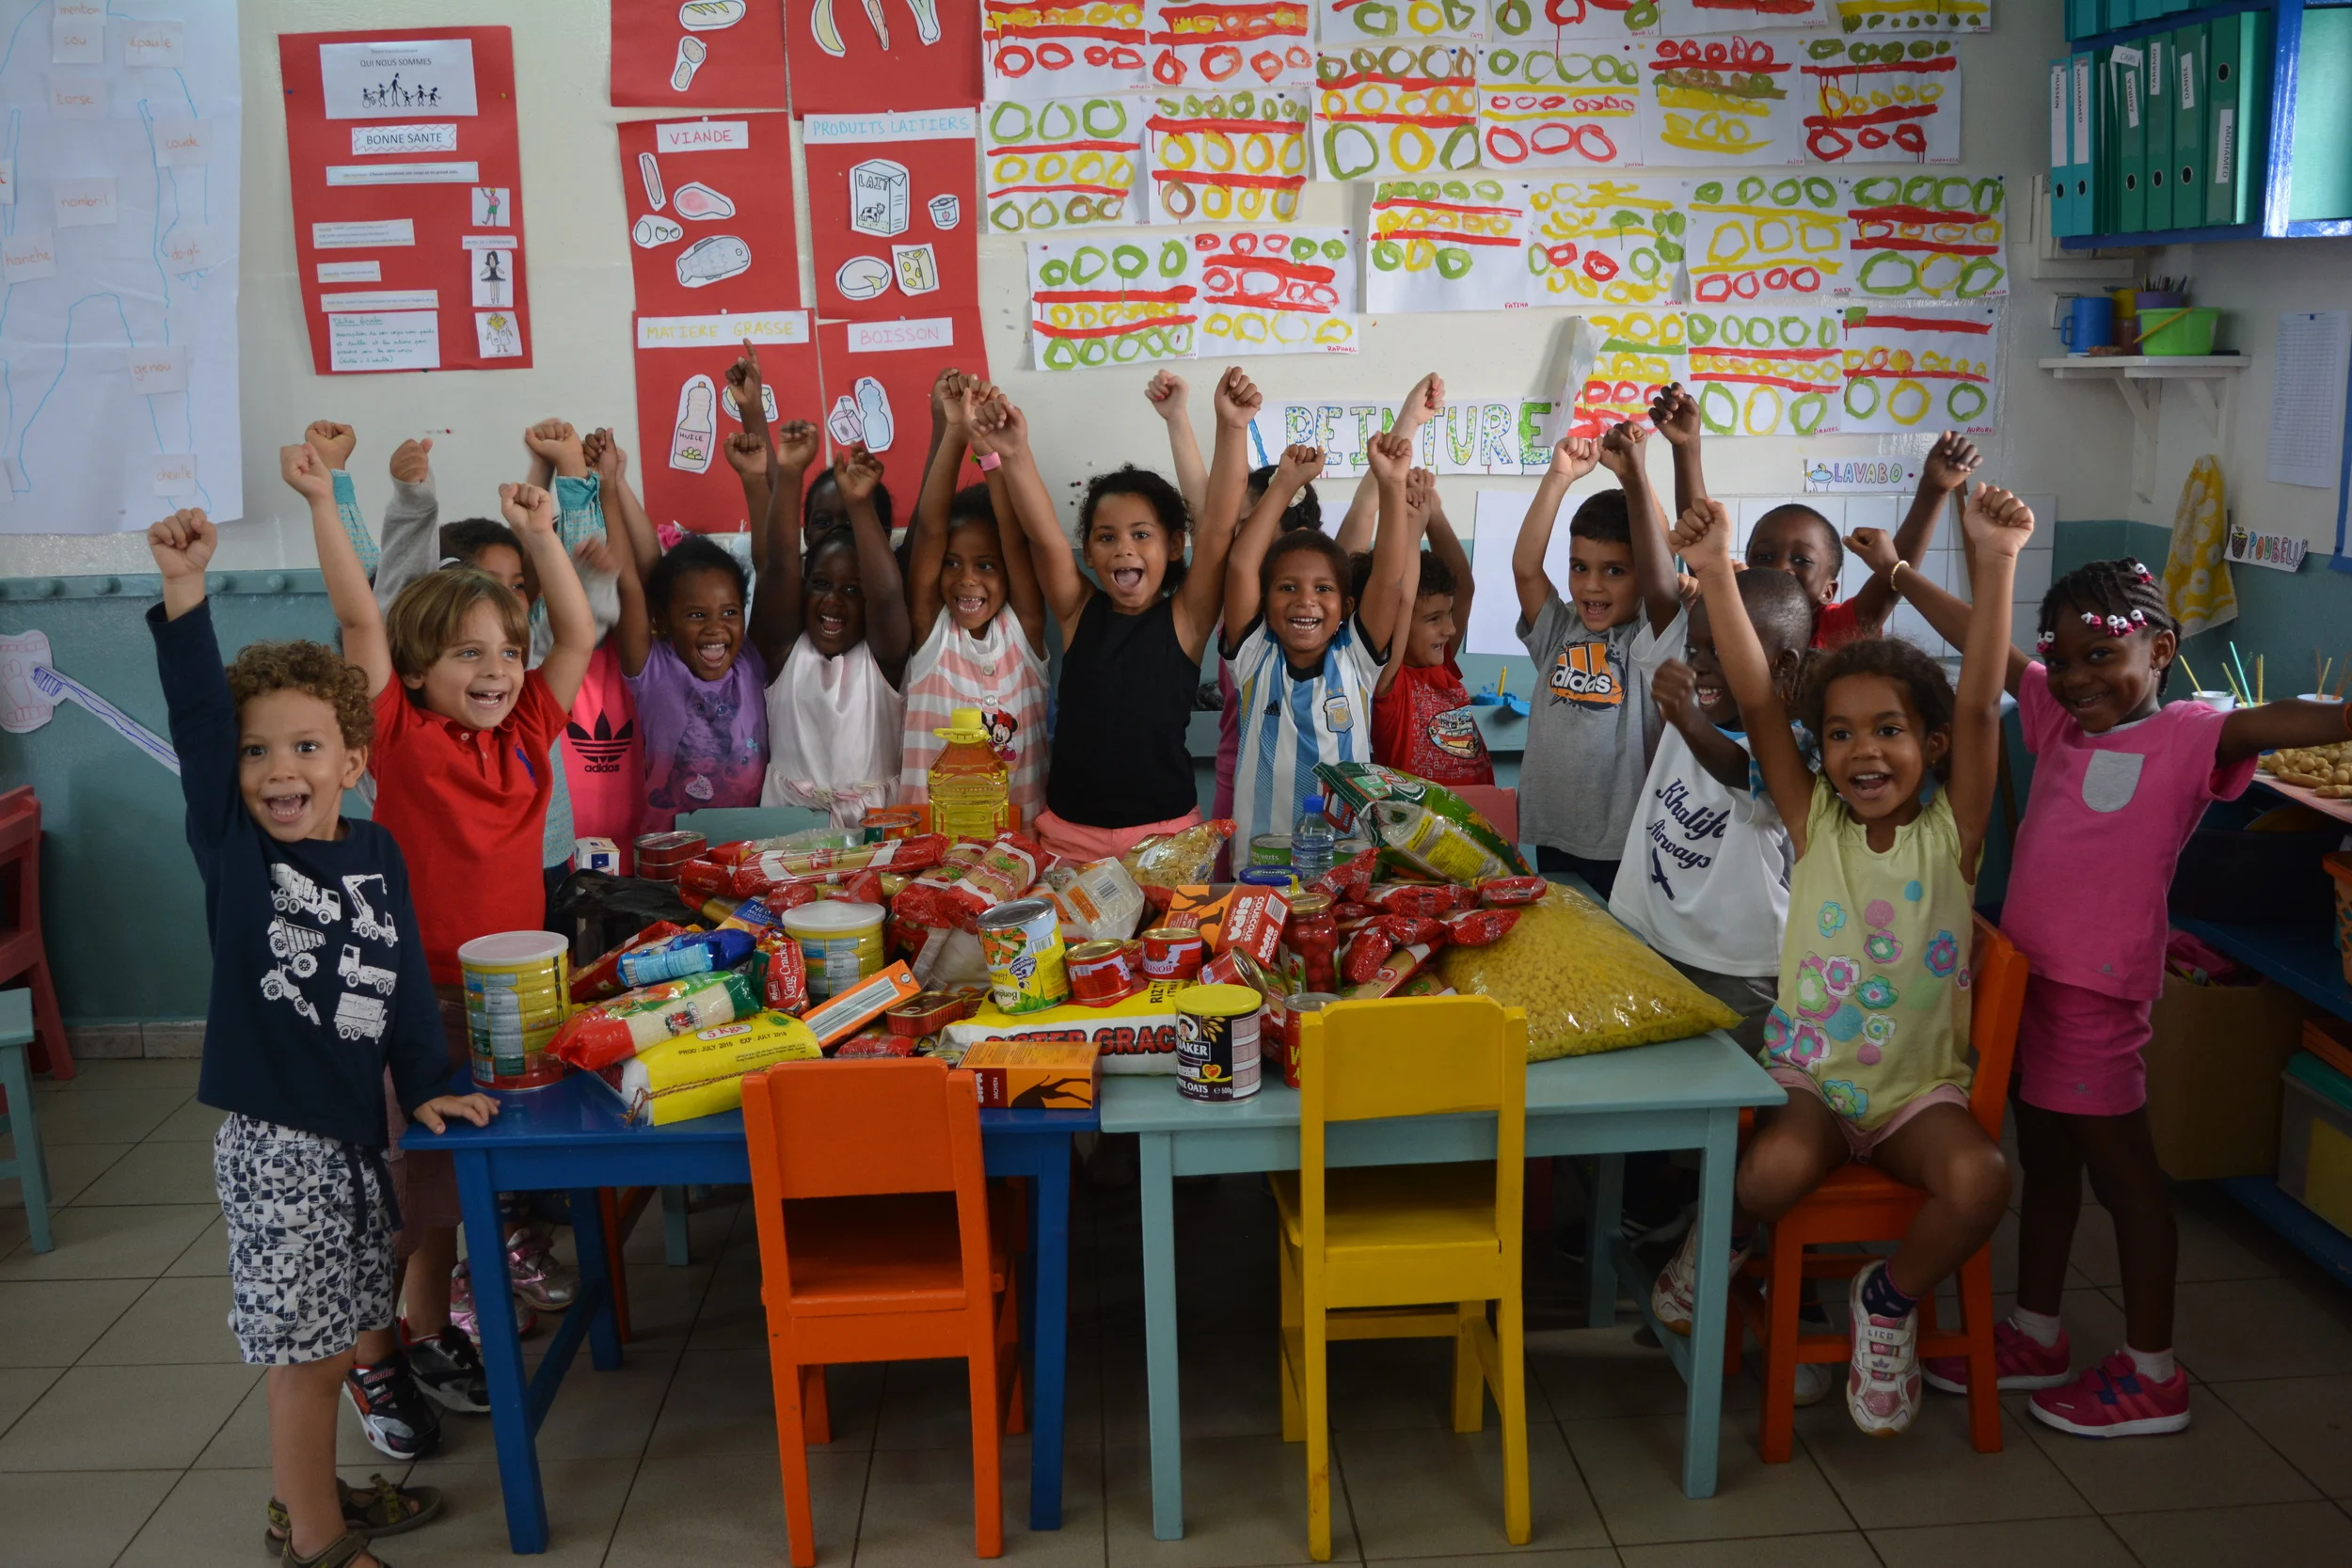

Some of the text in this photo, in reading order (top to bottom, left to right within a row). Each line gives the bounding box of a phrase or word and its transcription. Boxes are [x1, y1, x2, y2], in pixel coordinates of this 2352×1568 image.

[59, 3, 100, 15] menton
[63, 36, 87, 45] cou
[359, 57, 433, 68] QUI NOUS SOMMES
[56, 88, 94, 105] torse
[813, 116, 970, 137] PRODUITS LAITIERS
[165, 135, 199, 150] coude
[366, 132, 443, 145] BONNE SANTE
[670, 129, 733, 145] VIANDE
[2222, 125, 2232, 179] MOHAMED
[857, 174, 889, 191] LAIT
[61, 194, 109, 209] nombril
[3, 245, 53, 267] hanche
[171, 239, 200, 266] doigt
[646, 321, 794, 340] MATIERE GRASSE
[860, 326, 940, 345] BOISSON
[133, 363, 171, 381] genou
[679, 433, 704, 442] HUILE
[156, 464, 193, 482] cheville
[1835, 462, 1903, 483] LAVABO
[1551, 666, 1612, 693] didas
[584, 763, 620, 773] adidas
[1645, 818, 1711, 869] Airways
[1261, 852, 1279, 861] verts
[1227, 896, 1253, 941] SIPA
[1244, 895, 1265, 942] COUSCOUS
[1258, 924, 1275, 958] SIPA
[1265, 929, 1279, 964] COUSCOUS
[775, 942, 797, 1001] King Cracker
[707, 1024, 744, 1038] 5 Kgs
[701, 1044, 716, 1053] JULY
[739, 1037, 752, 1045] EXP
[1092, 1024, 1176, 1056] GRAC
[1177, 1040, 1209, 1057] UAKER
[1186, 1082, 1209, 1094] OATS
